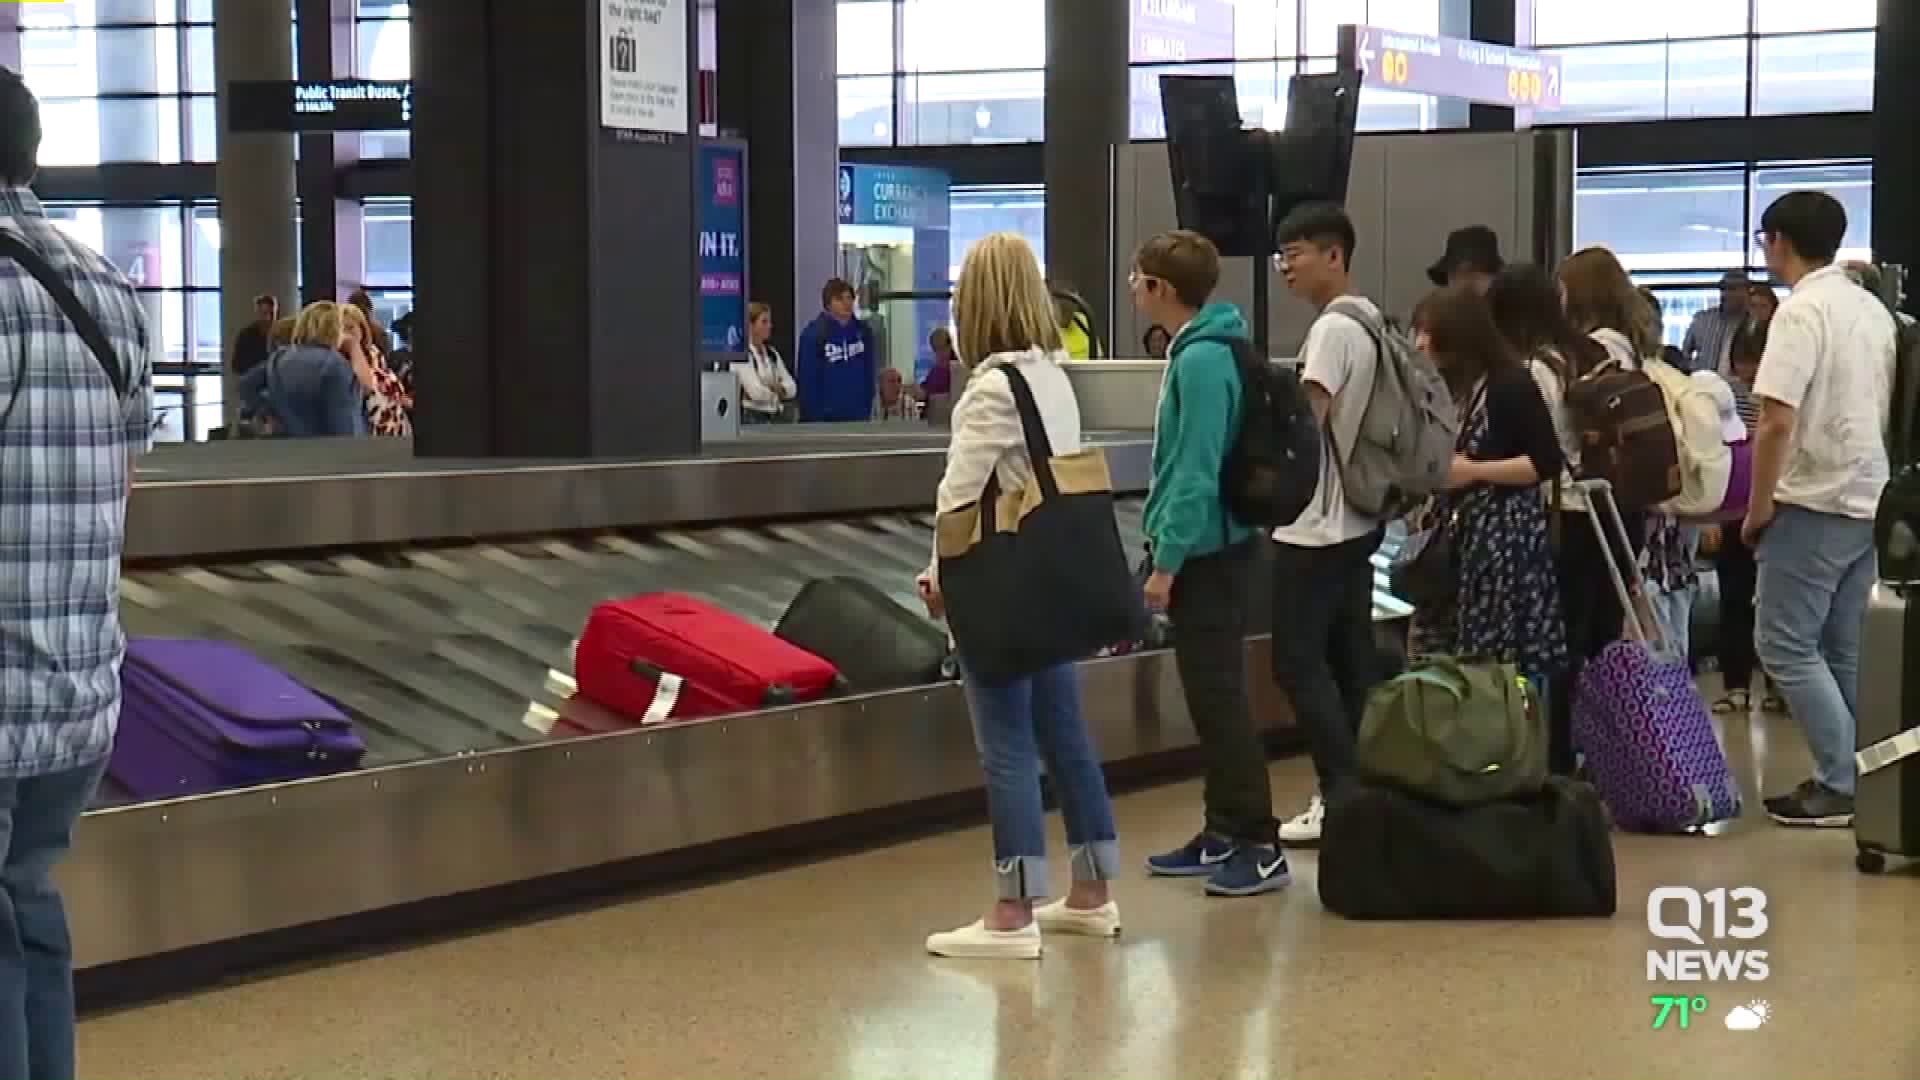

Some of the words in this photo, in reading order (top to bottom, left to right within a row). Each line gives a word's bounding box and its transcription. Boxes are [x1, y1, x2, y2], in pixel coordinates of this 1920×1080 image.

[295, 86, 328, 99] Public
[328, 85, 366, 100] Transit
[128, 255, 145, 285] 4
